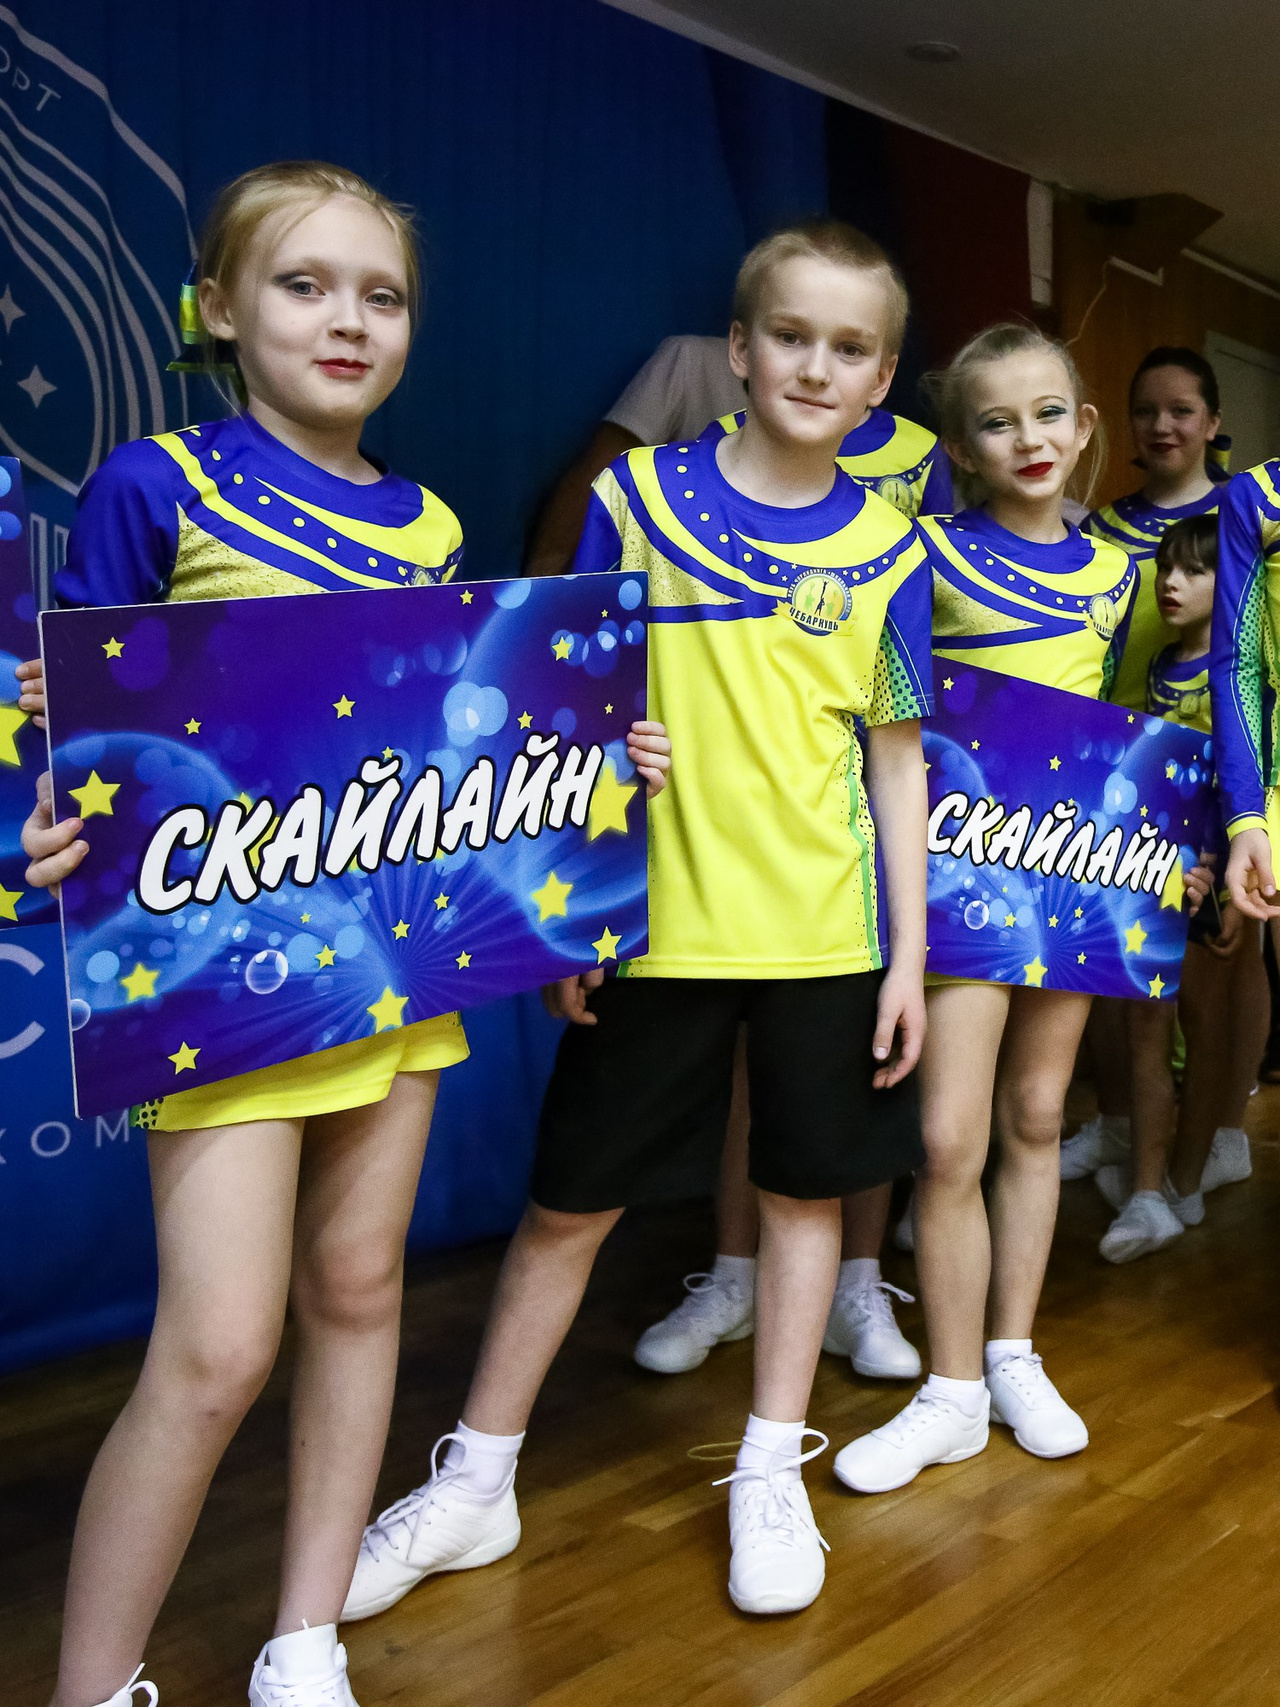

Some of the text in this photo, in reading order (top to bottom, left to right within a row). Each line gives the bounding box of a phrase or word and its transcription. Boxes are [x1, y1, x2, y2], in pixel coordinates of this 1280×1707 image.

[789, 607, 839, 631] ЧЕБАРКУЛЬ
[138, 733, 604, 914] СКАЙЛАЙН
[928, 790, 1179, 897] СКАЙЛАЙН
